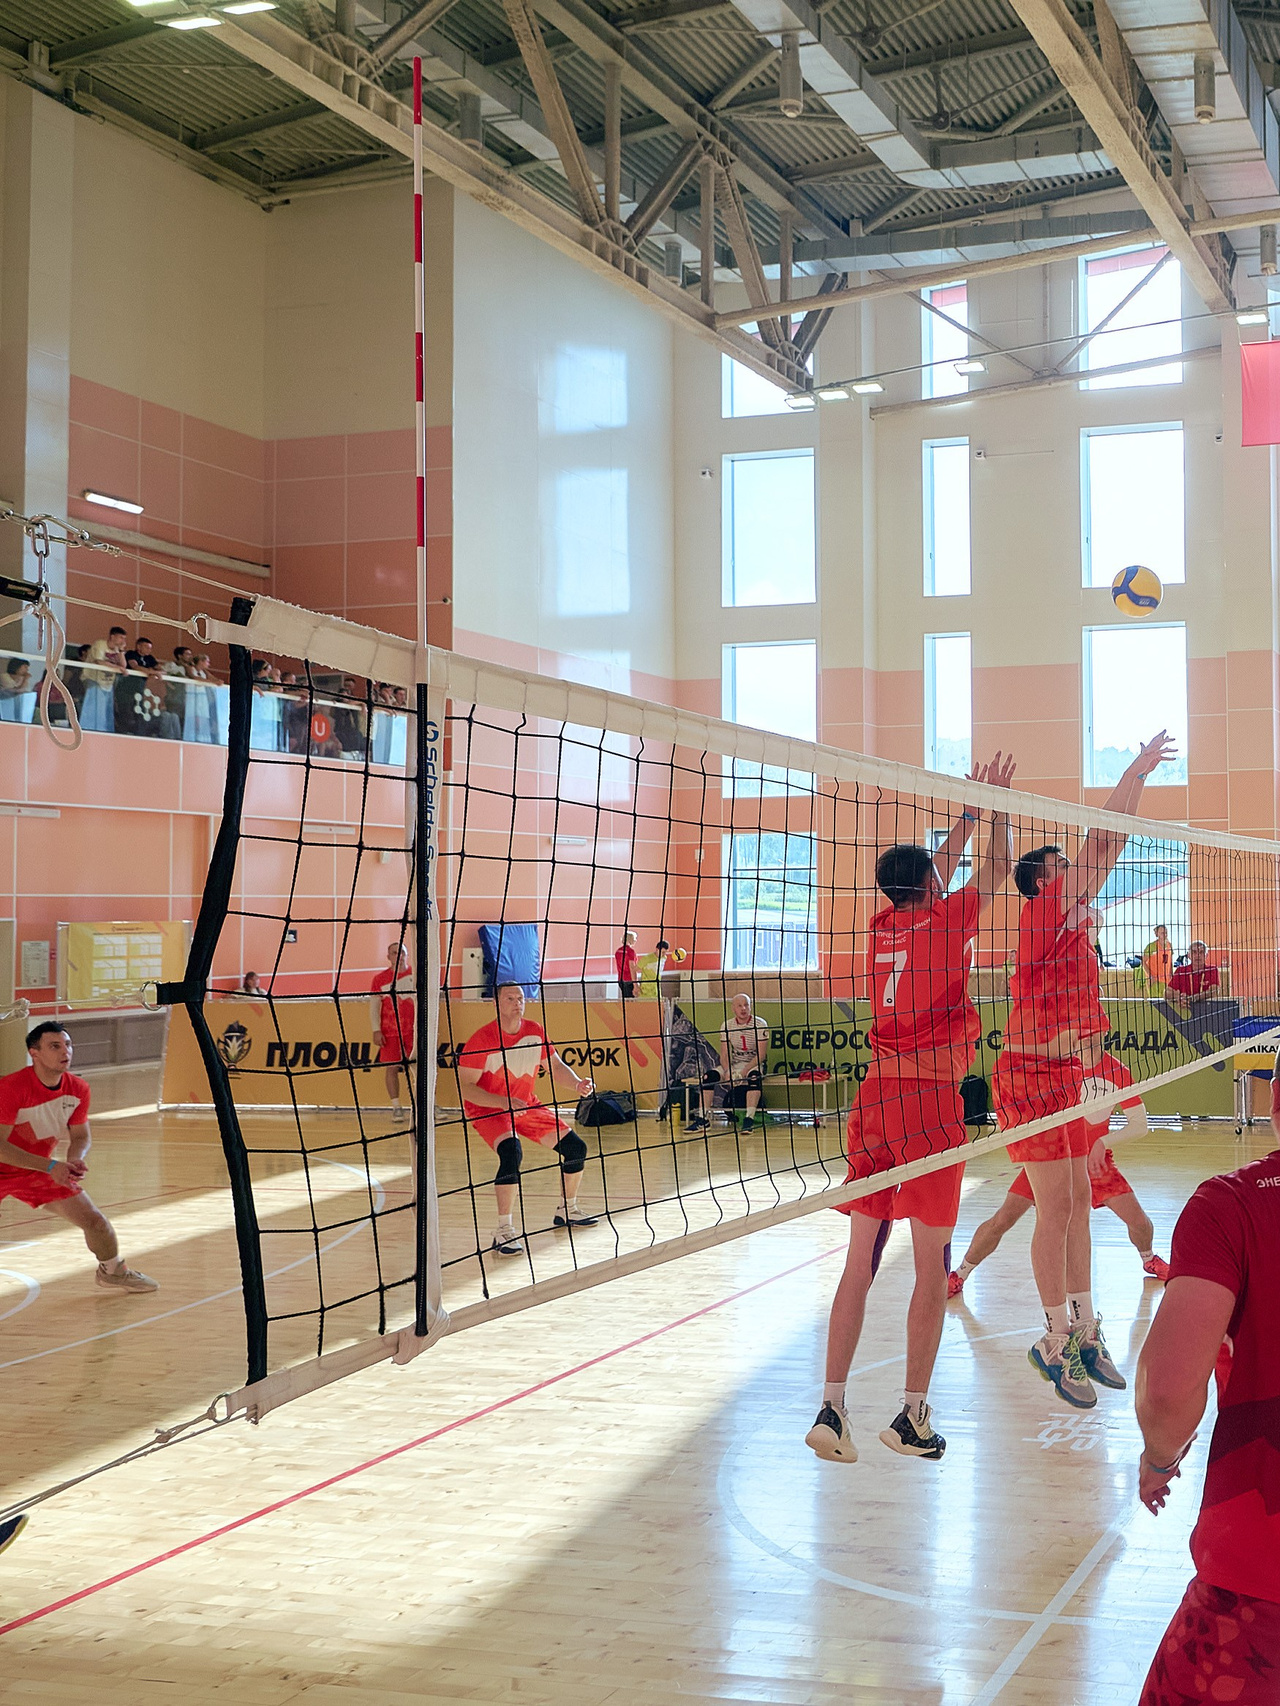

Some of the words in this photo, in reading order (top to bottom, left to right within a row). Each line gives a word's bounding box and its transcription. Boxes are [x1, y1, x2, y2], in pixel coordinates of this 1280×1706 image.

[875, 949, 908, 1008] 7
[740, 1035, 749, 1052] 1
[1244, 1044, 1280, 1054] MIKA
[561, 1047, 621, 1067] СУЭК
